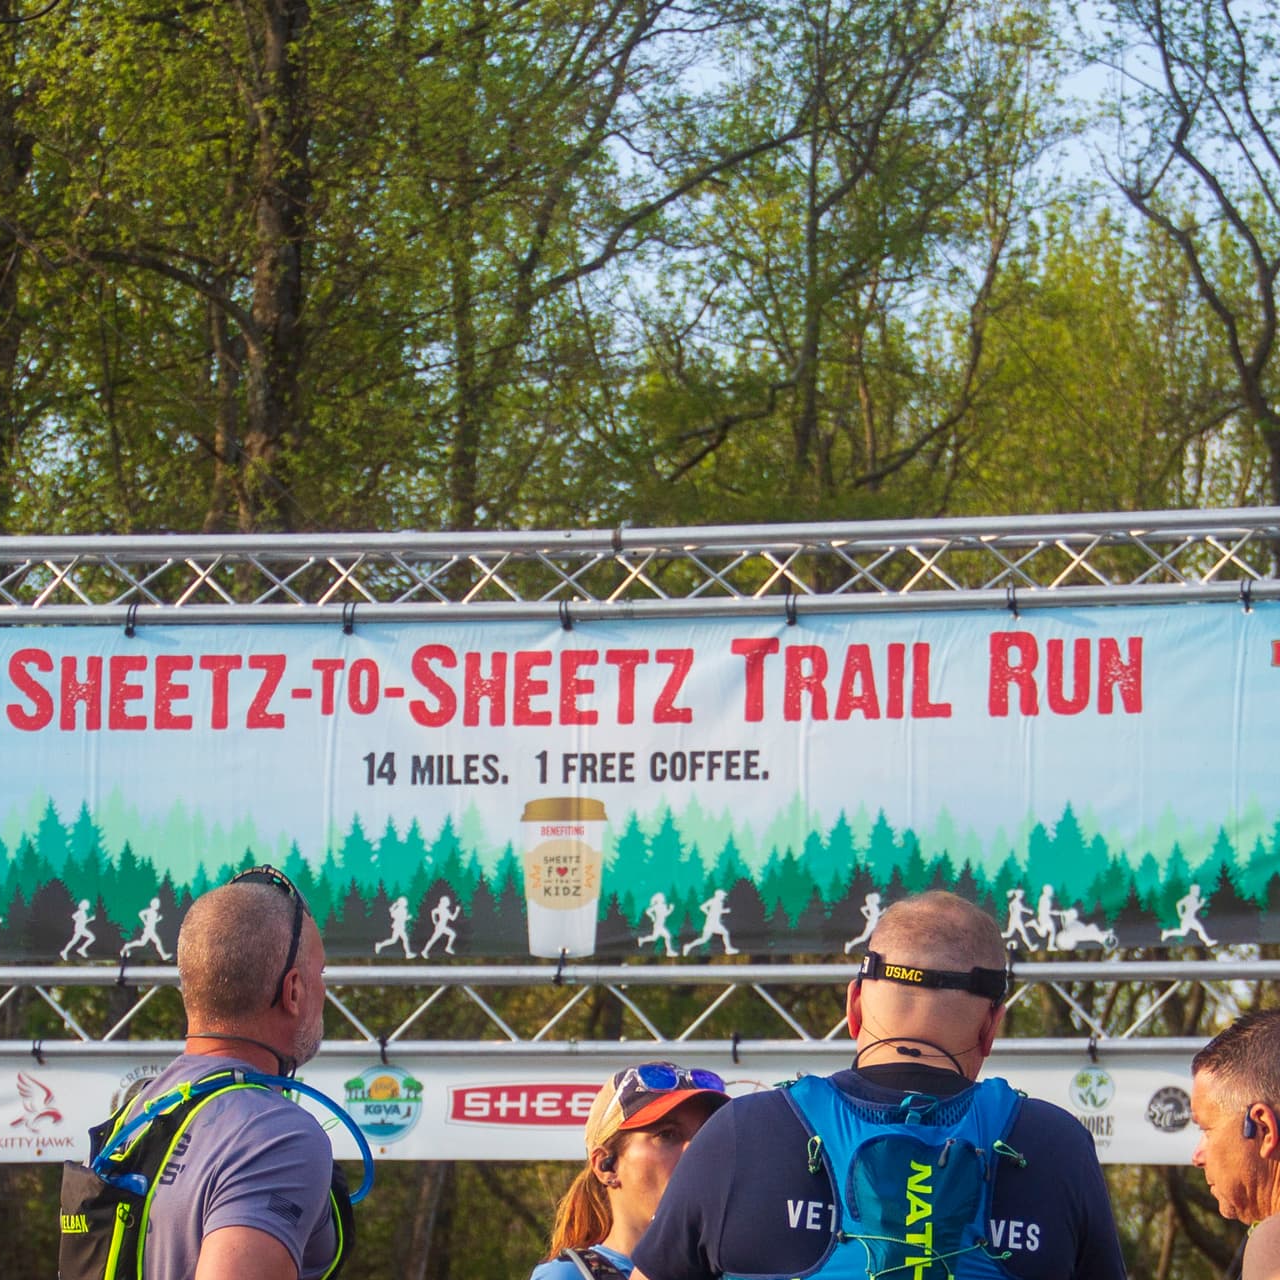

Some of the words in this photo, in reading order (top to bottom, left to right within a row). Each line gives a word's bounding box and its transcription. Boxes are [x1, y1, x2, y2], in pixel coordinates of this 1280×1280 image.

[730, 637, 953, 723] TRAIL
[988, 631, 1143, 717] RUN
[362, 752, 397, 785] 14
[410, 754, 509, 785] MILES.
[534, 750, 548, 784] 1
[561, 752, 635, 783] FREE
[649, 749, 770, 782] COFFEE.
[540, 825, 585, 837] BENEFITING
[543, 885, 582, 897] KIDZ
[885, 965, 924, 983] USMC
[364, 1103, 402, 1115] KGVA
[36, 1136, 75, 1148] HAWK
[989, 1219, 1041, 1251] VES
